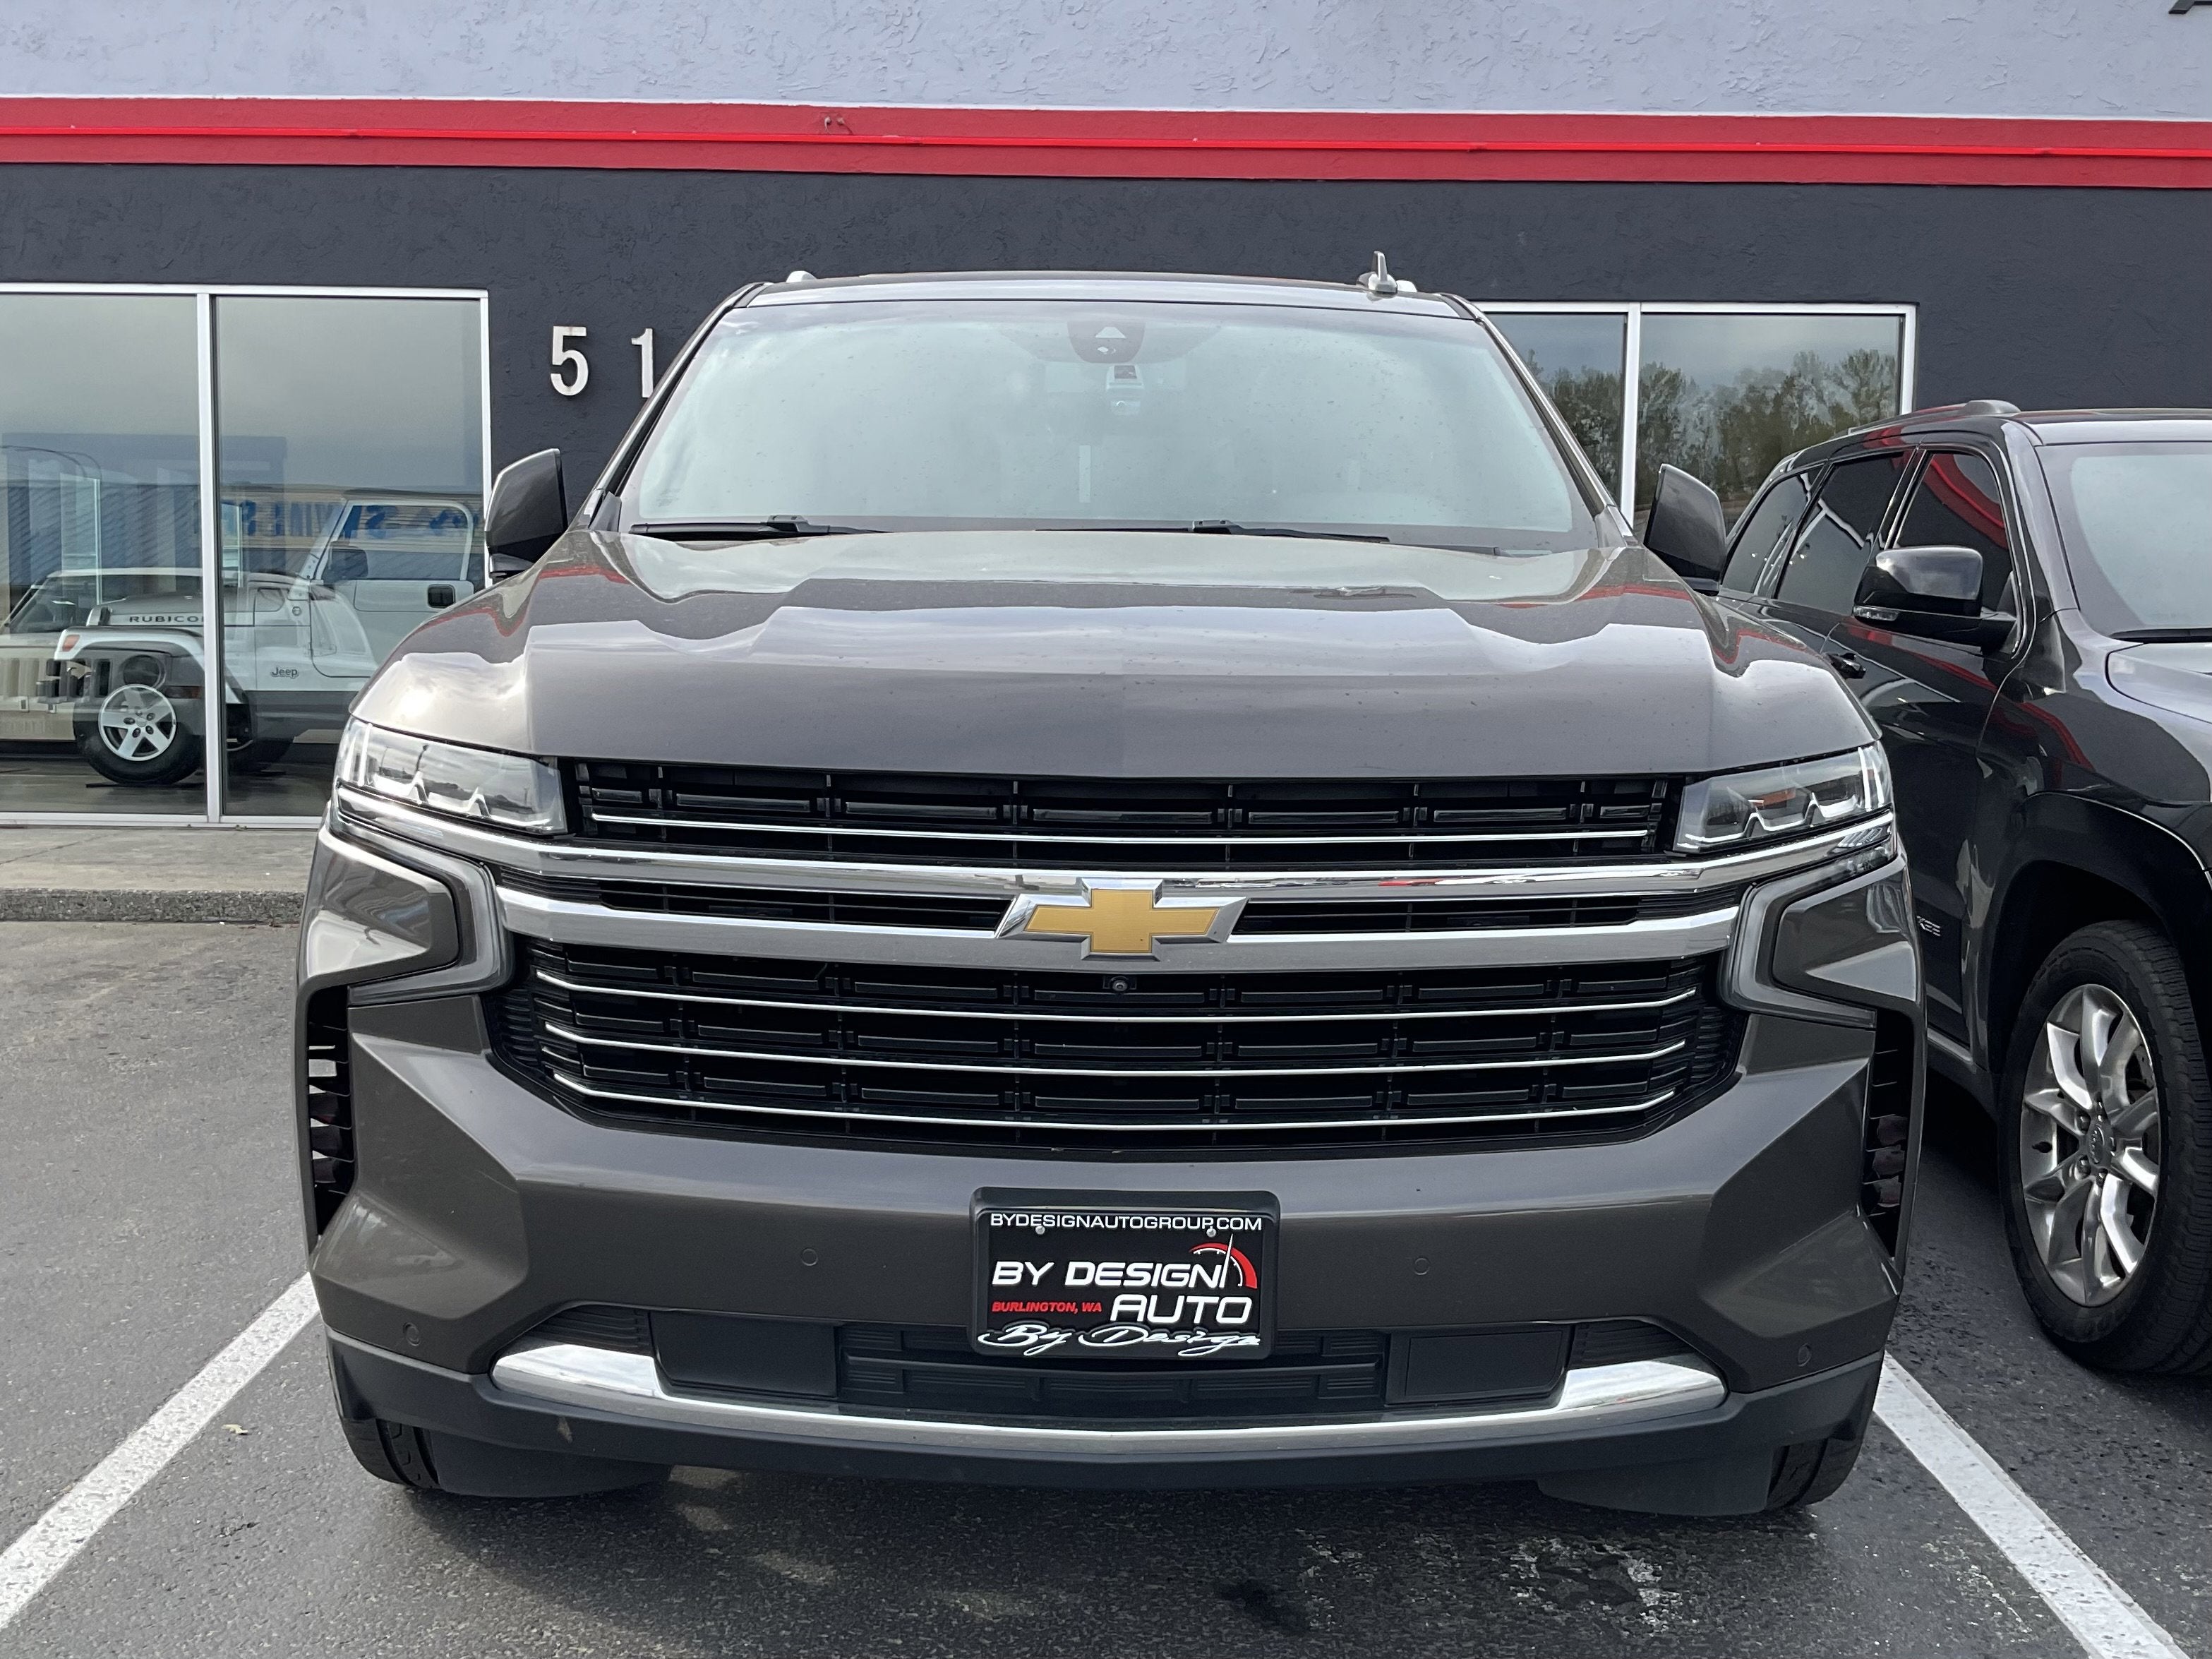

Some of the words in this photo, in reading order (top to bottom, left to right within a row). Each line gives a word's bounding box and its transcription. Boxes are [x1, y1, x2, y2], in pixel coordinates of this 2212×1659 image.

[272, 667, 298, 678] Jeep
[990, 1213, 1262, 1230] BYDESIGNAUTOGROUP.COM
[992, 1261, 1054, 1286] BY
[1065, 1262, 1225, 1288] DESIGN
[992, 1301, 1078, 1314] BURLINGTON,
[1081, 1302, 1102, 1312] WA
[1110, 1294, 1252, 1324] AUTO
[978, 1324, 1072, 1356] By
